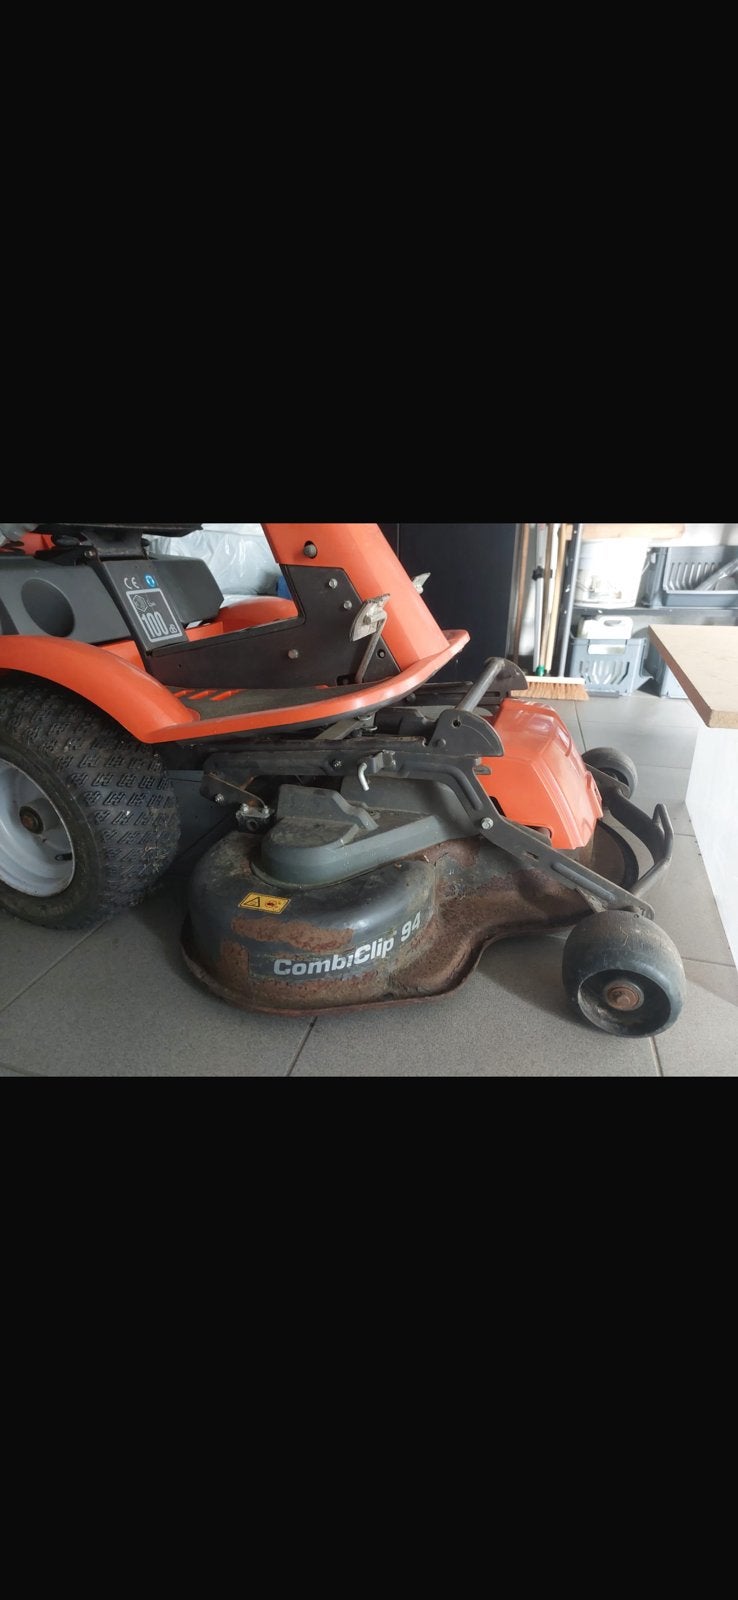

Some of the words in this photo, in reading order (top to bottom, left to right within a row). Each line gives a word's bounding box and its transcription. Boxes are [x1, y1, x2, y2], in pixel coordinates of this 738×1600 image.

[124, 577, 140, 589] CE
[142, 611, 169, 638] 100
[273, 937, 394, 976] CombiClip
[401, 911, 421, 943] 94
